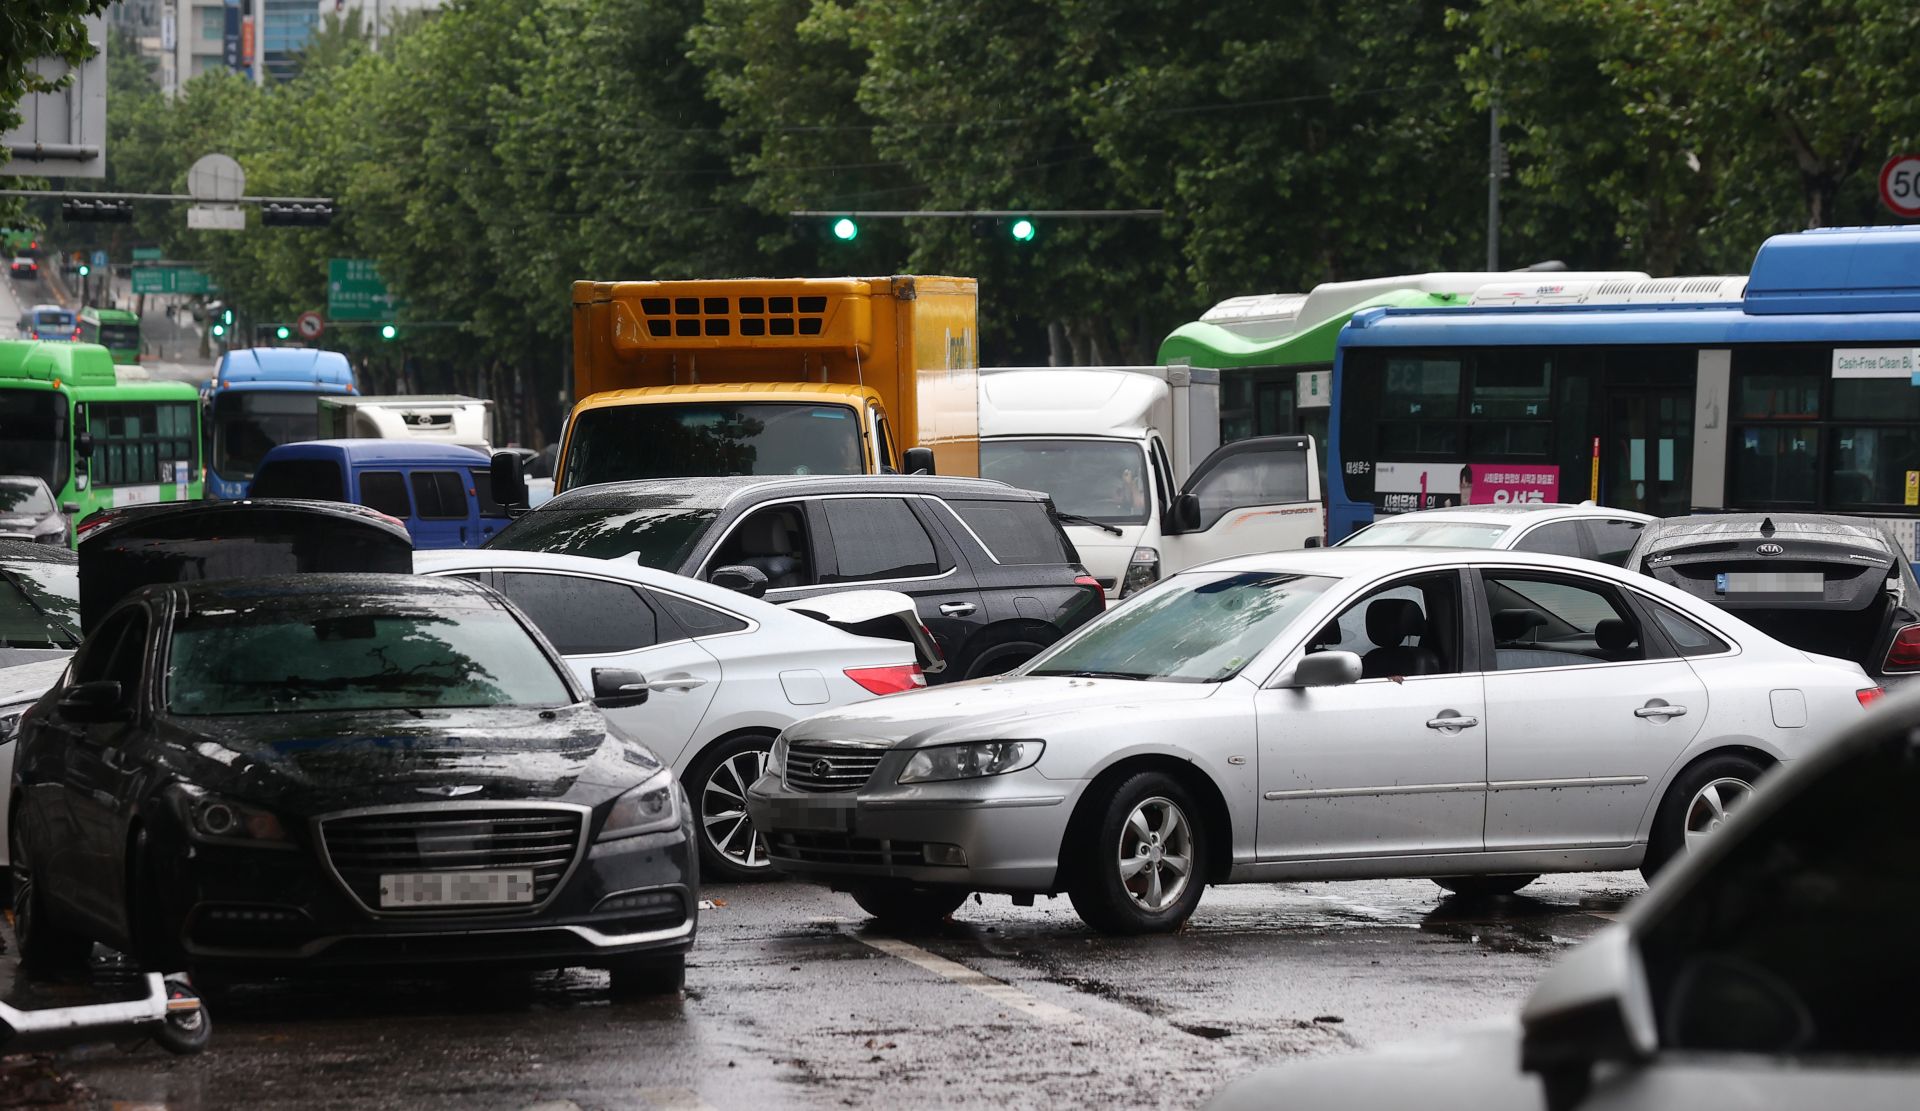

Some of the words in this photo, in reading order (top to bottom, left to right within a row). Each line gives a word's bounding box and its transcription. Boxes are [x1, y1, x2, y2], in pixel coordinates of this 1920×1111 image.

[1839, 356, 1877, 369] Cash-Free
[1879, 356, 1899, 369] Clean
[1345, 461, 1370, 474] 대성운수
[220, 482, 242, 496] 143
